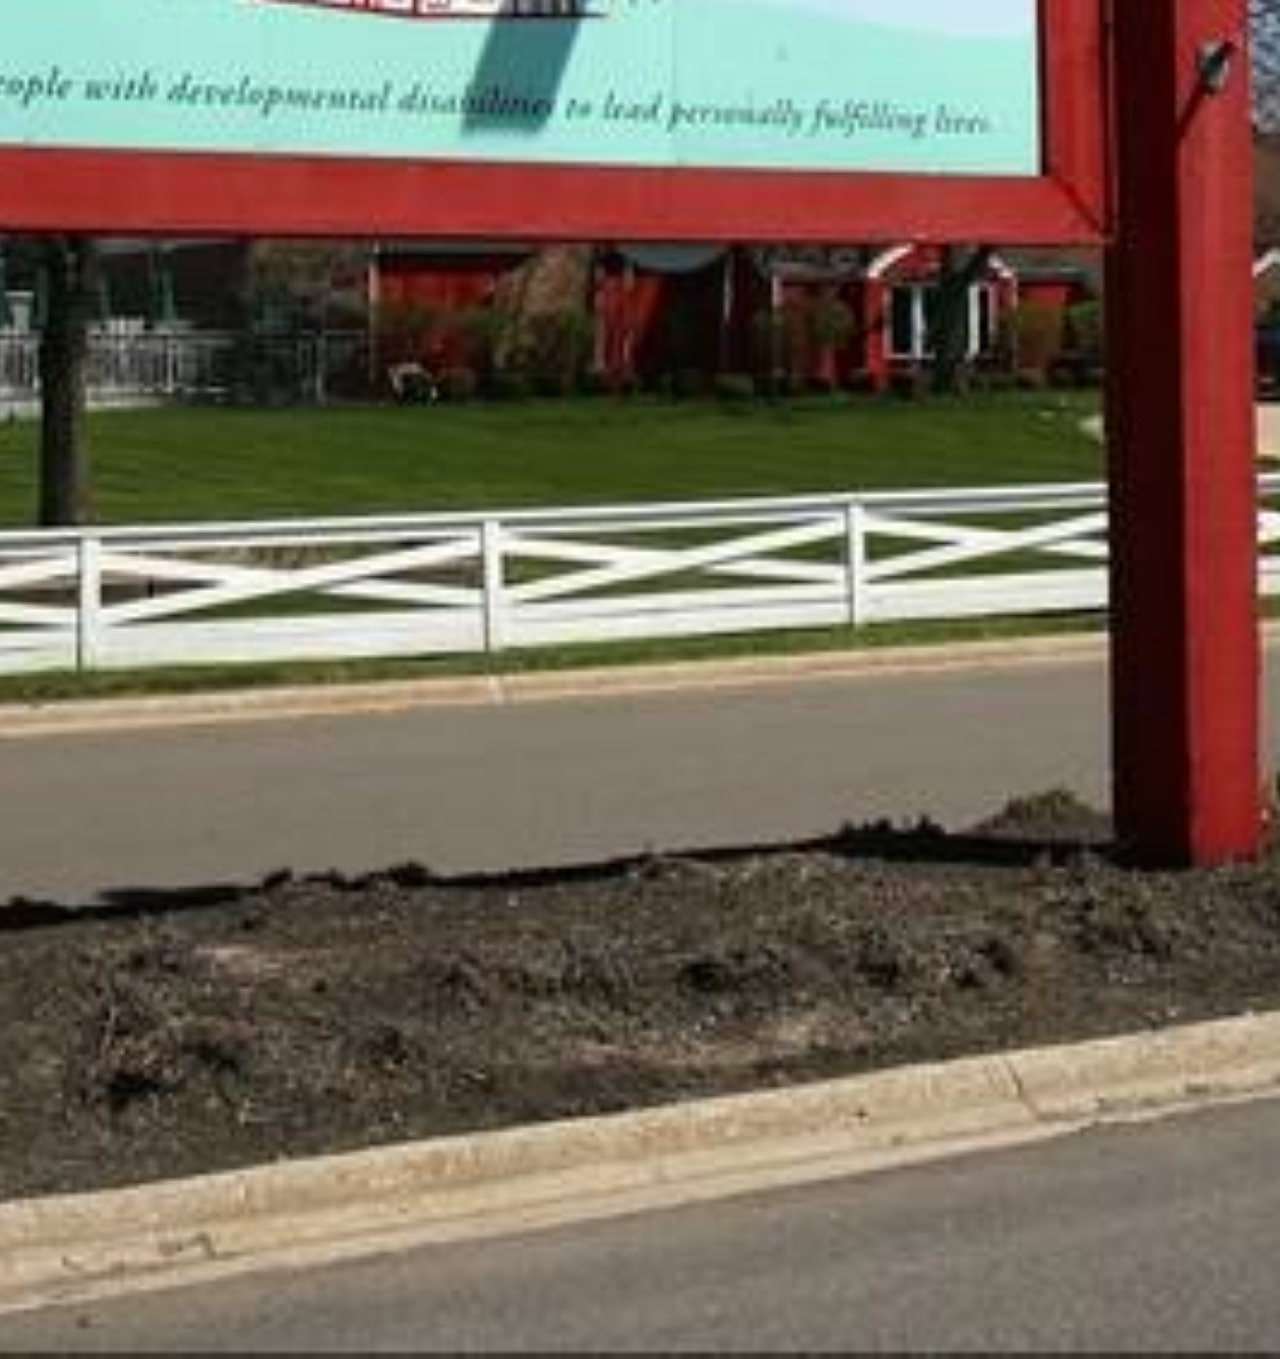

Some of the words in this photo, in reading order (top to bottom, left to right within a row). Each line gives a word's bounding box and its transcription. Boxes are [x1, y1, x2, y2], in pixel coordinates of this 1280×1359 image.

[84, 69, 159, 101] with
[167, 73, 393, 117] developmental
[397, 81, 554, 116] disabil
[566, 96, 591, 122] to
[603, 90, 662, 123] lead
[666, 98, 803, 138] personally
